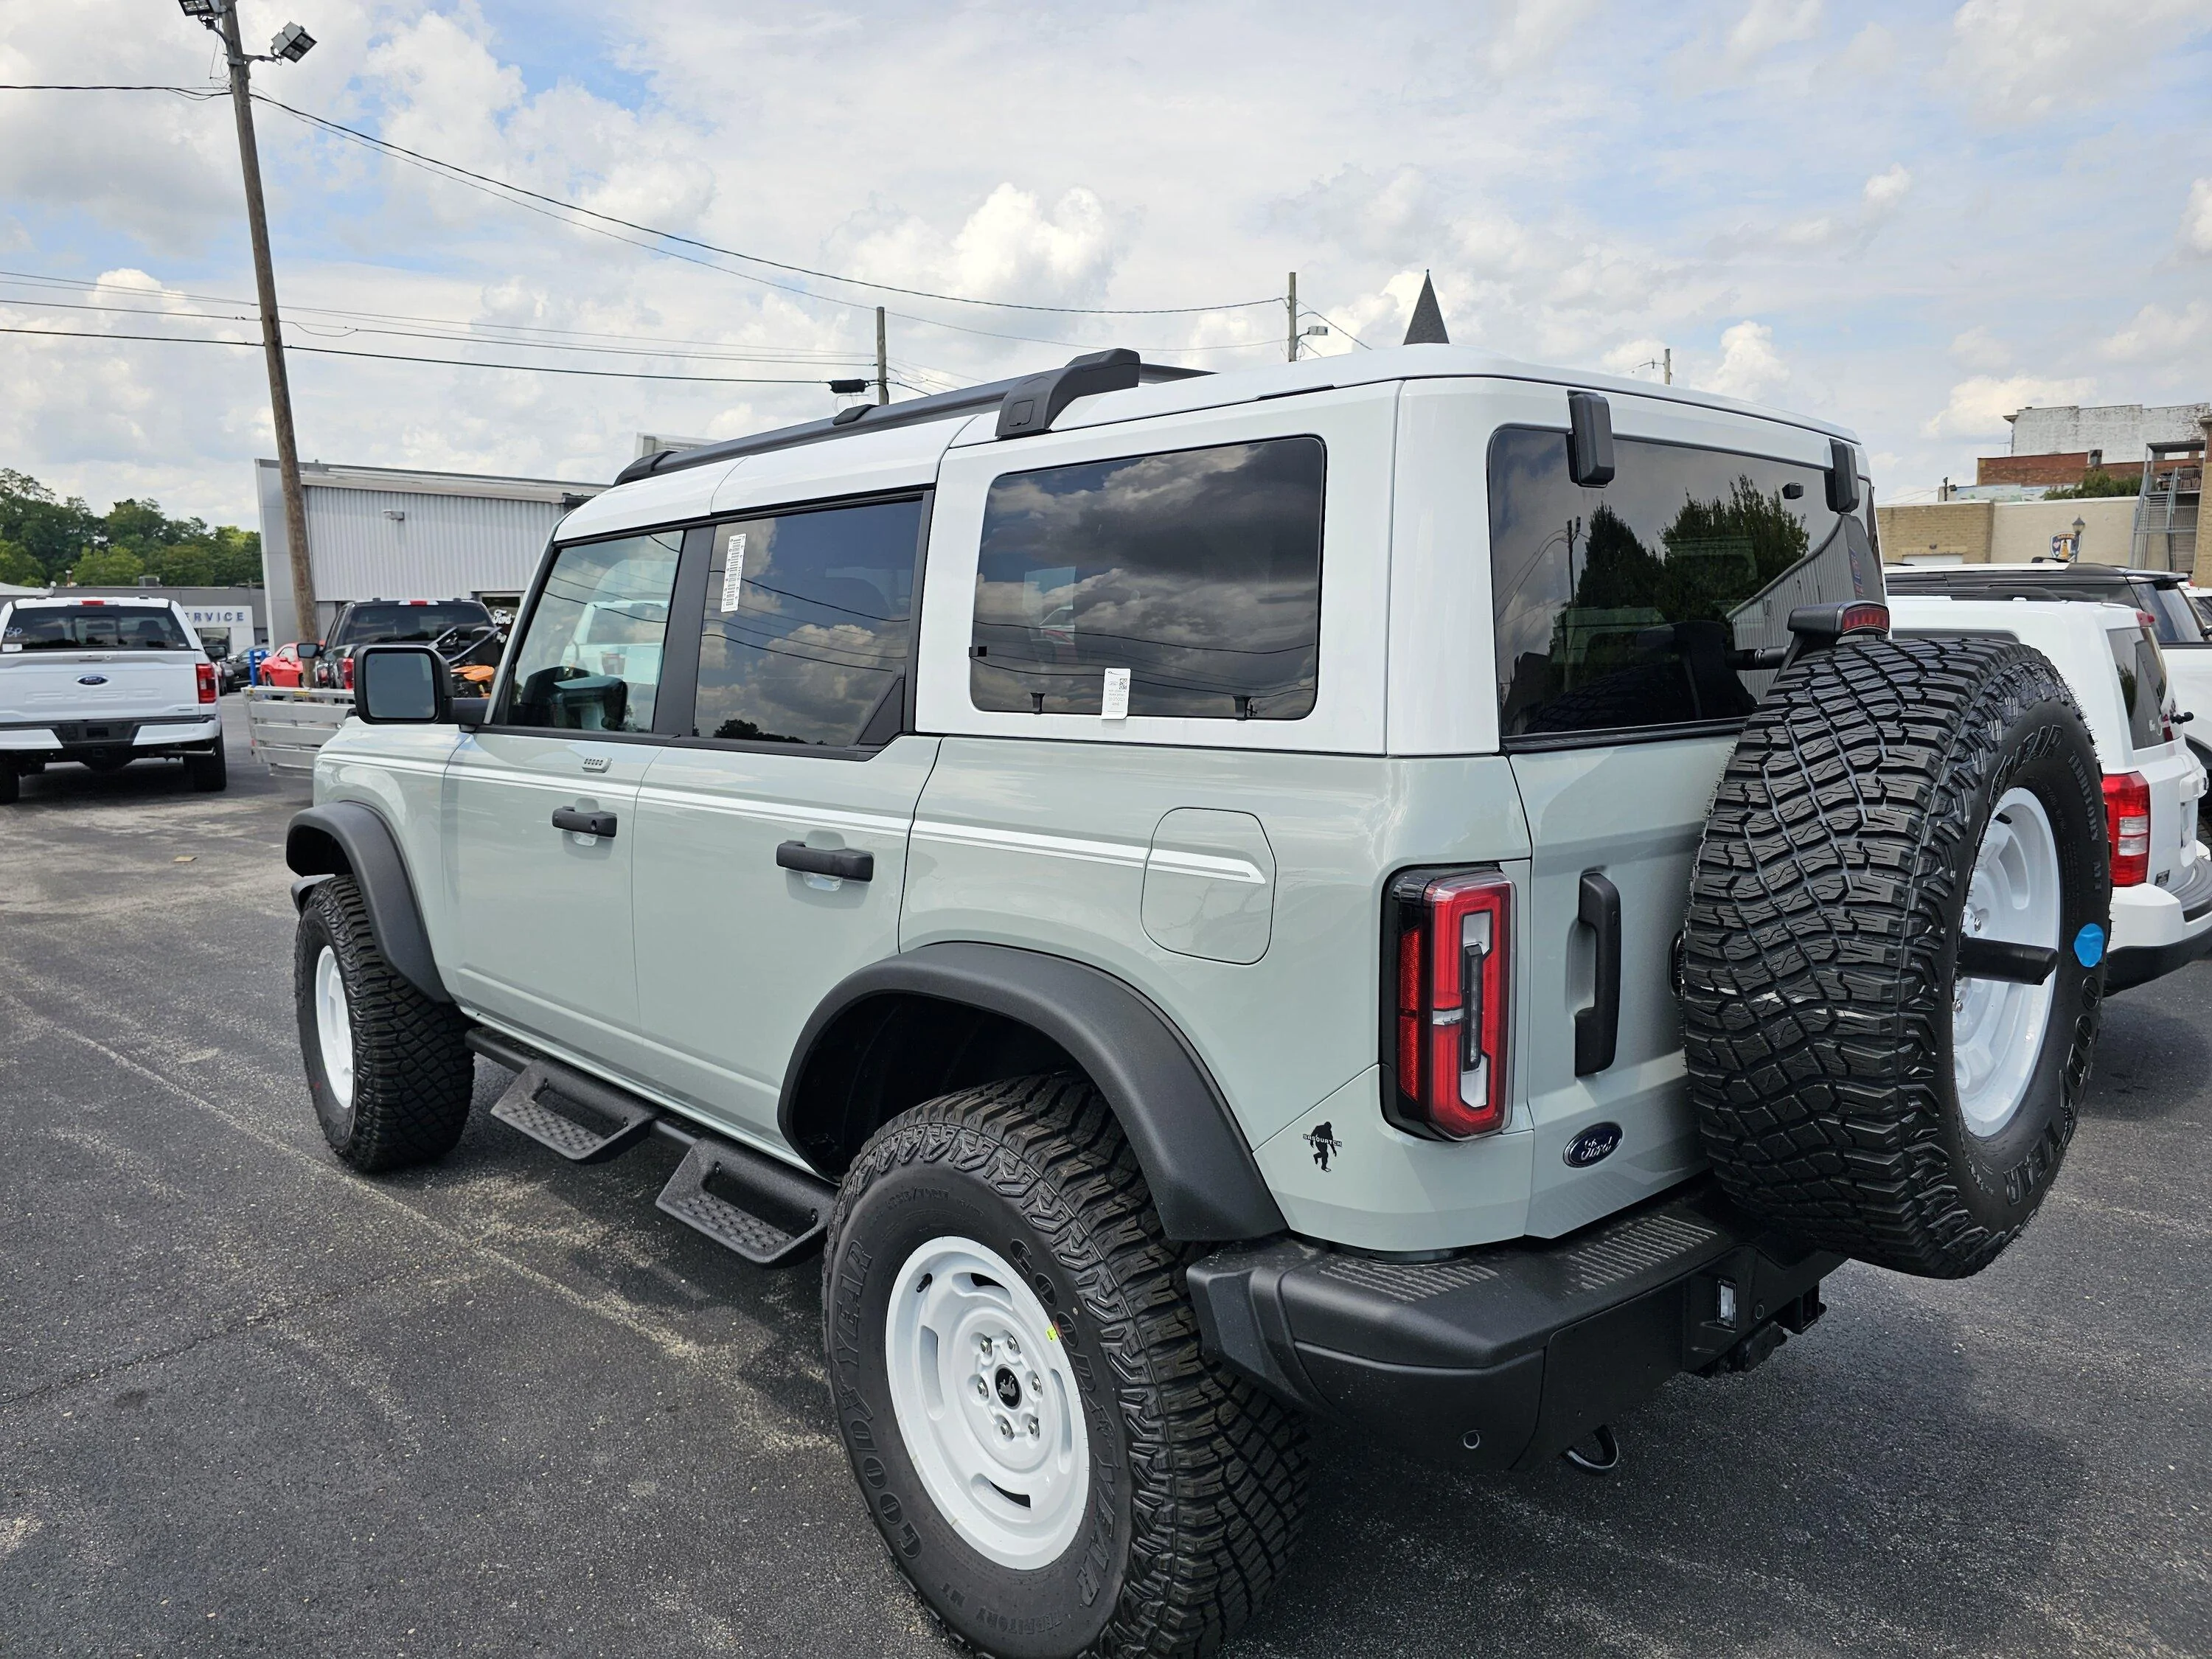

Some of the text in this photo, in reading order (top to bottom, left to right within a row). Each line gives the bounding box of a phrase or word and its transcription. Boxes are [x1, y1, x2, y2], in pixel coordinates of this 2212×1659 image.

[185, 612, 244, 621] RVICE
[1581, 1136, 1613, 1161] Ford
[2003, 975, 2098, 1206] OODYEAR
[835, 1239, 922, 1559] GOODYEAR
